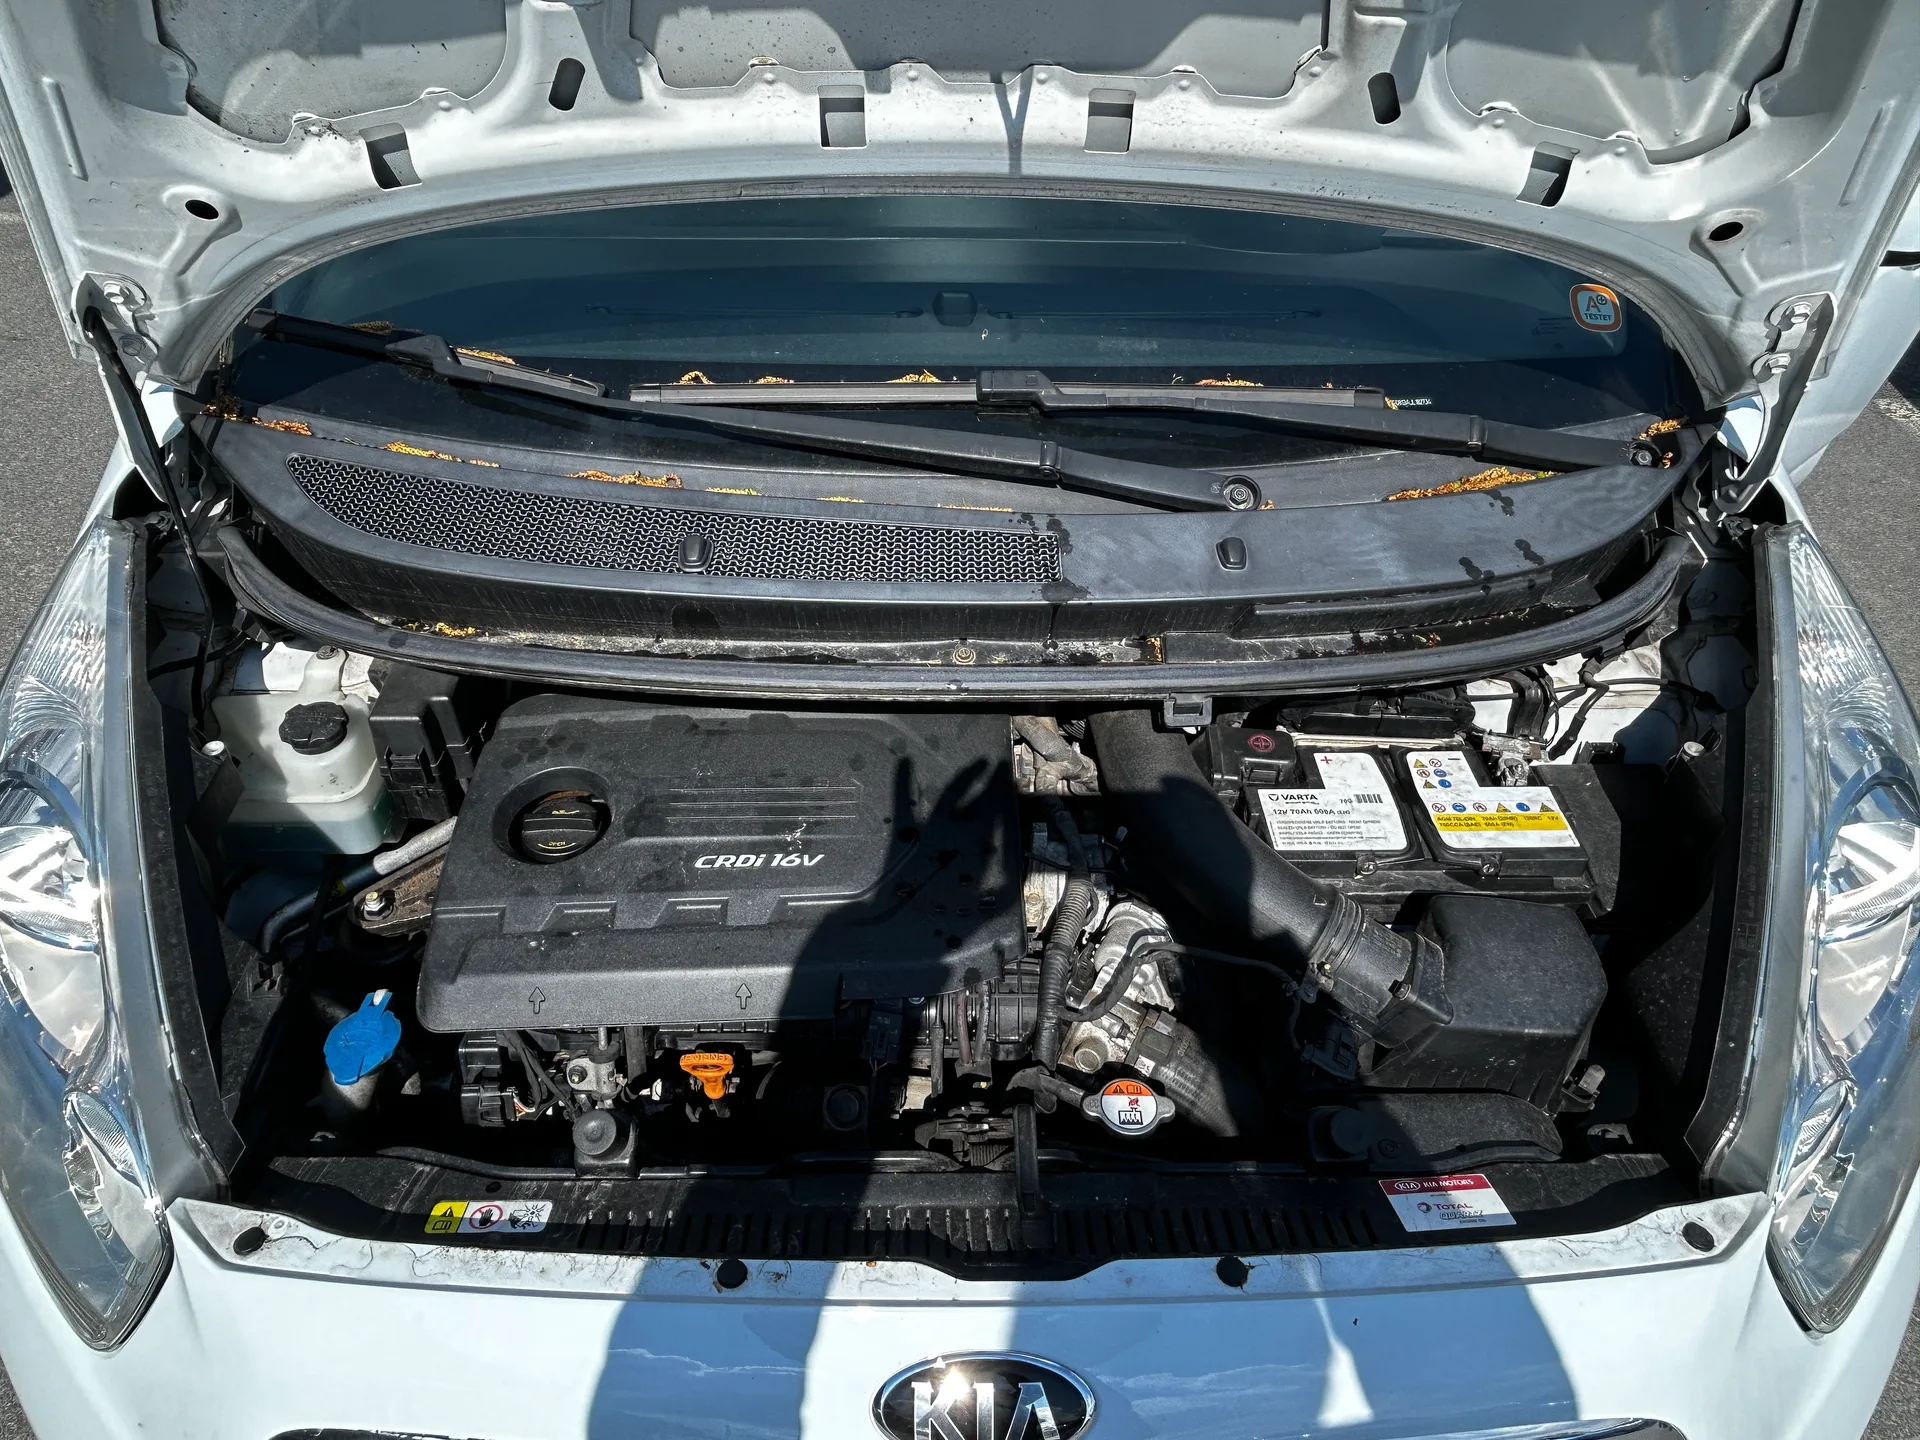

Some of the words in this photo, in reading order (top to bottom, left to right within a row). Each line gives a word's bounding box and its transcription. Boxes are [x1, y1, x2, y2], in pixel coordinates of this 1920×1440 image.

[1584, 313, 1612, 321] TESTET
[694, 854, 766, 868] CRDi
[770, 853, 825, 867] 16V
[1400, 1182, 1417, 1190] KIA
[1433, 1202, 1473, 1210] TOTAL
[911, 1381, 1061, 1440] KIA
